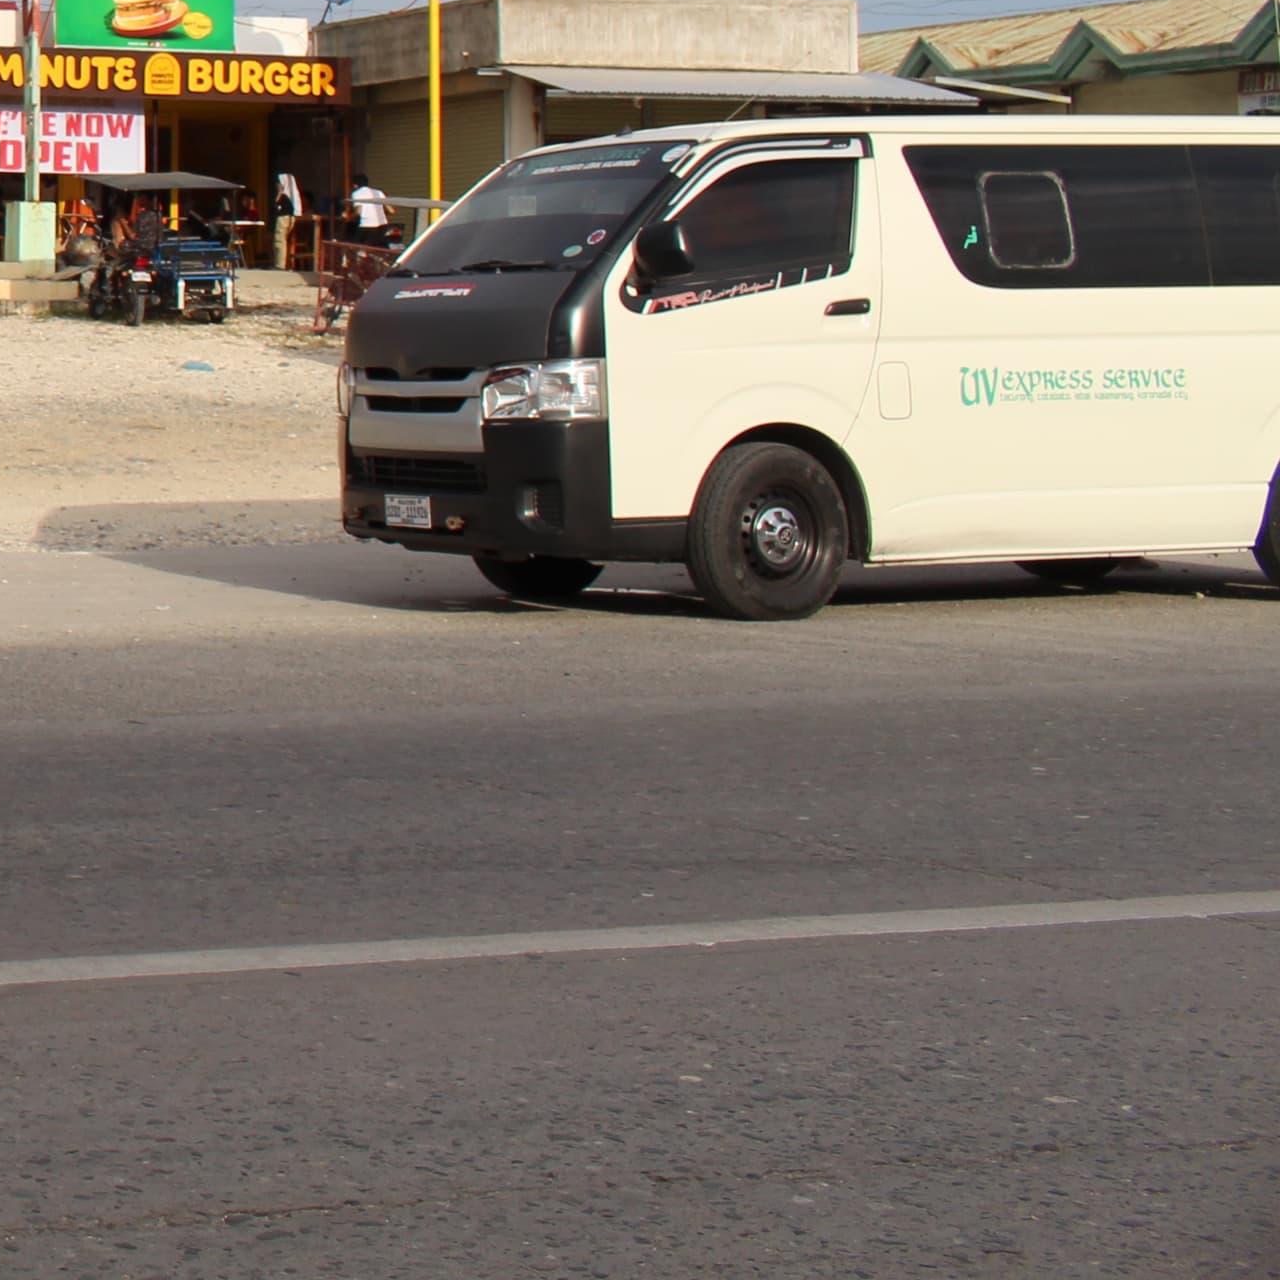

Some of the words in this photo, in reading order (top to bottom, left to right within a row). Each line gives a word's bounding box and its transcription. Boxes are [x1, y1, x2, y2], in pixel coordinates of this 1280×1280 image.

[188, 58, 336, 97] BURGER
[66, 113, 134, 138] NOW
[959, 366, 999, 407] UV
[1102, 368, 1186, 389] SERVICE
